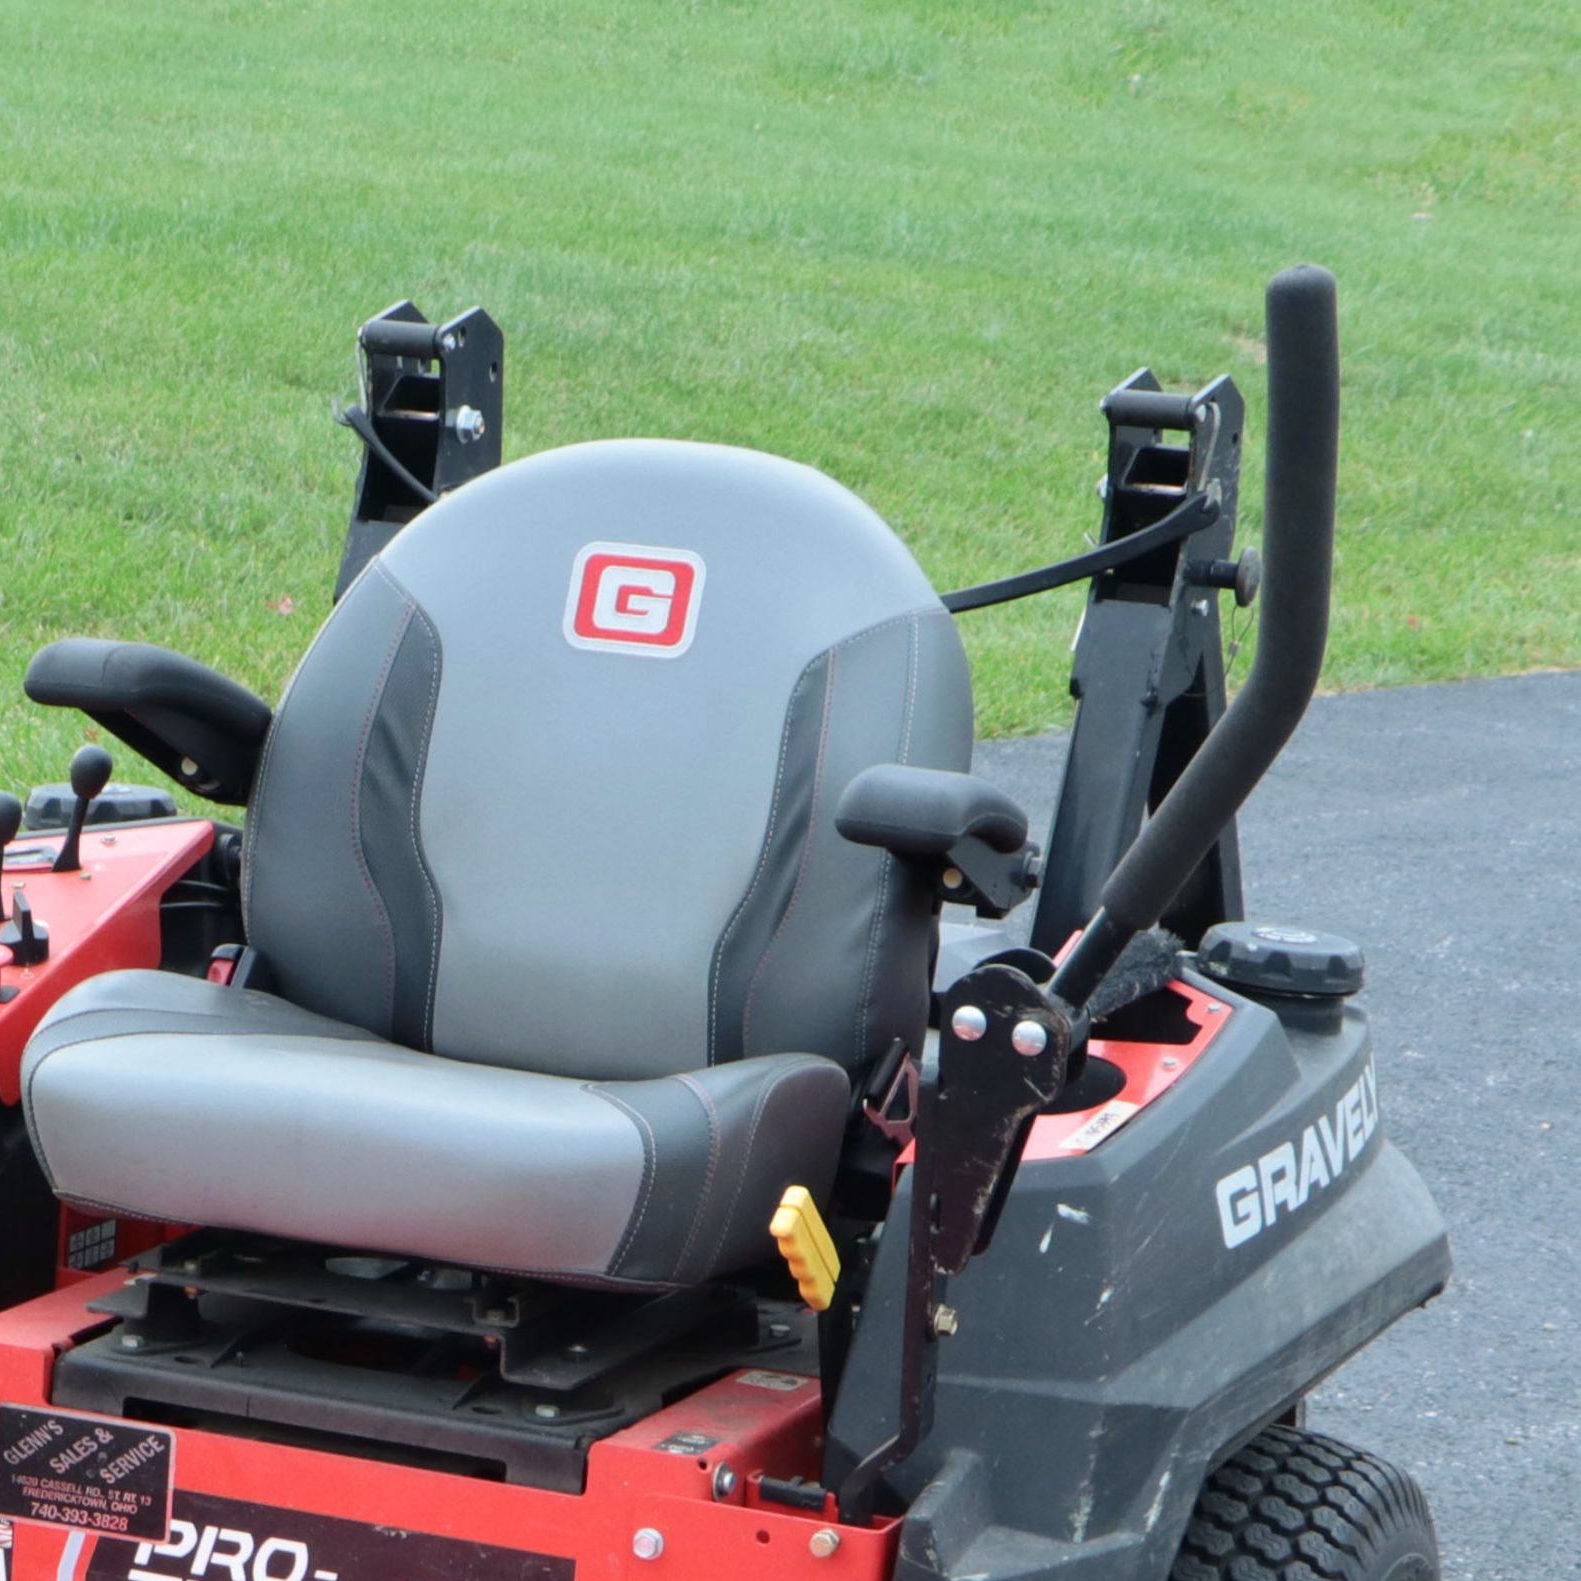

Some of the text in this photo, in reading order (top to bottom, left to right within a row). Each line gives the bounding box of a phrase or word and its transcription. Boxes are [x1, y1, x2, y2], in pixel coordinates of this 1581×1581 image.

[590, 562, 679, 638] G
[1216, 1050, 1379, 1249] GRAVELY
[3, 1419, 64, 1465] GLENN'S
[49, 1427, 115, 1474] SALES &
[99, 1434, 166, 1485] SERVICE
[40, 1478, 82, 1494] CASSELL
[140, 1495, 152, 1506] 13
[110, 1501, 138, 1515] OHIO
[30, 1501, 129, 1532] 740-393-3828
